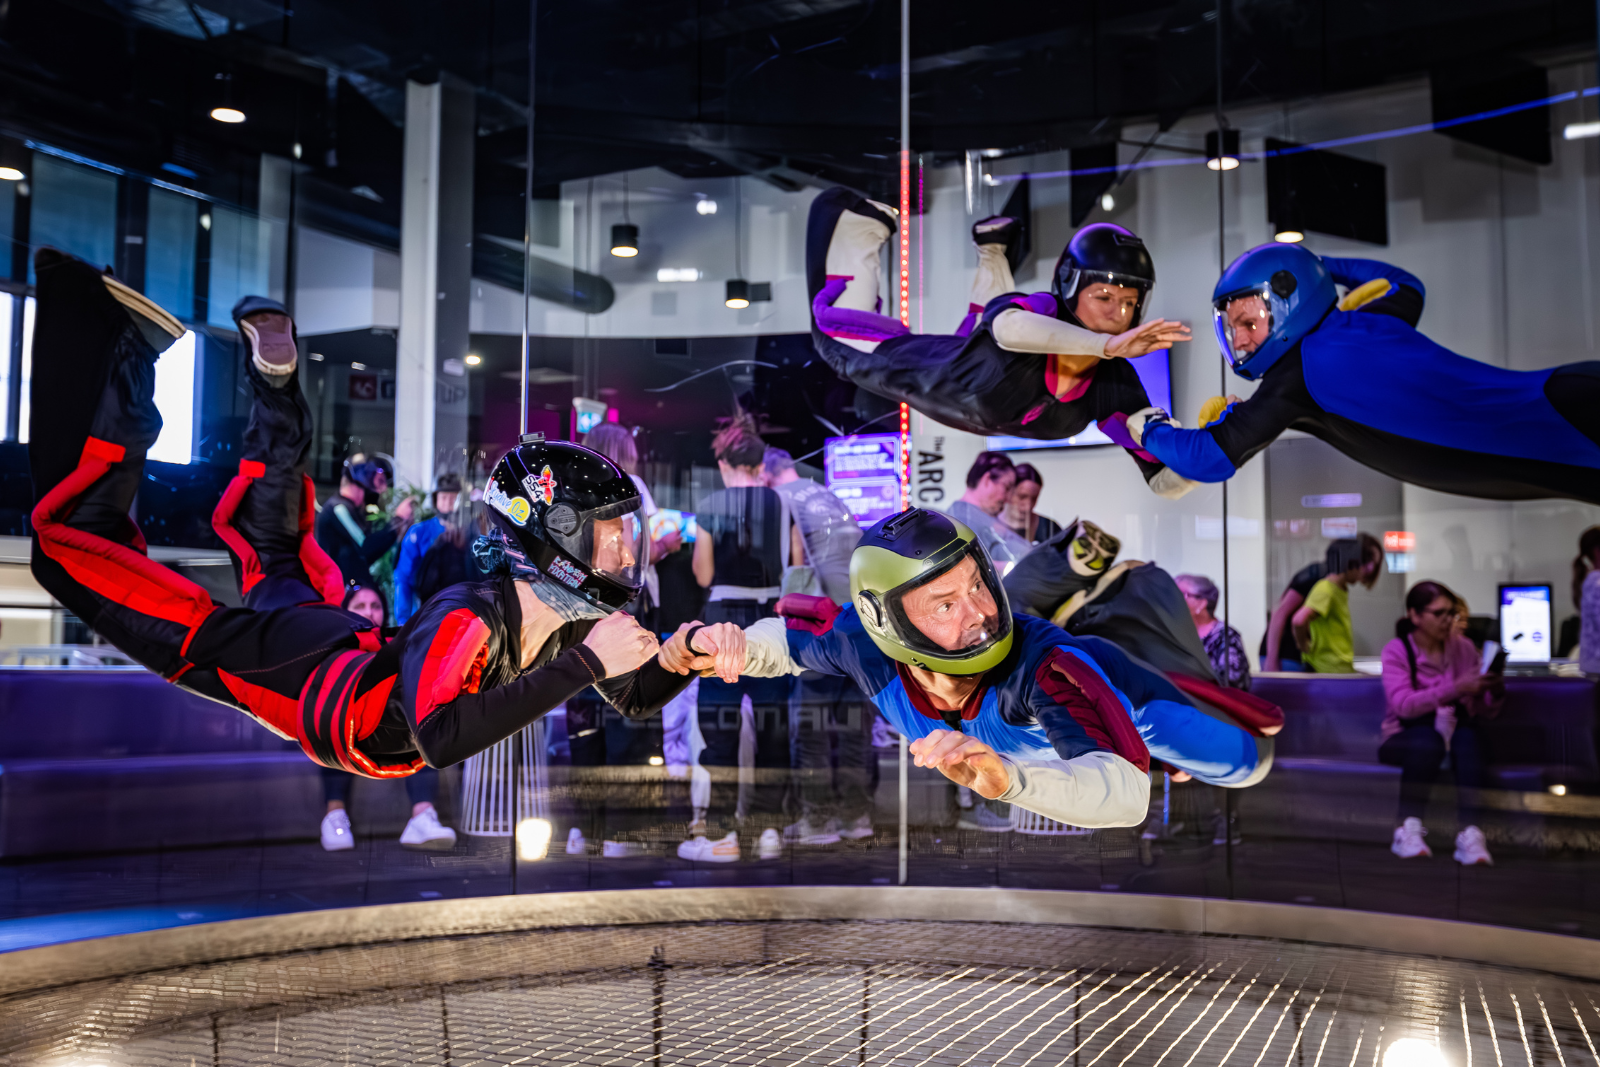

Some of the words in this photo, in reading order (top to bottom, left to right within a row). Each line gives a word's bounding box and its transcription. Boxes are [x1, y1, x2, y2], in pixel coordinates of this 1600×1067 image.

[525, 475, 544, 499] SS4
[918, 450, 944, 502] ARC
[547, 564, 583, 589] FIXATION
